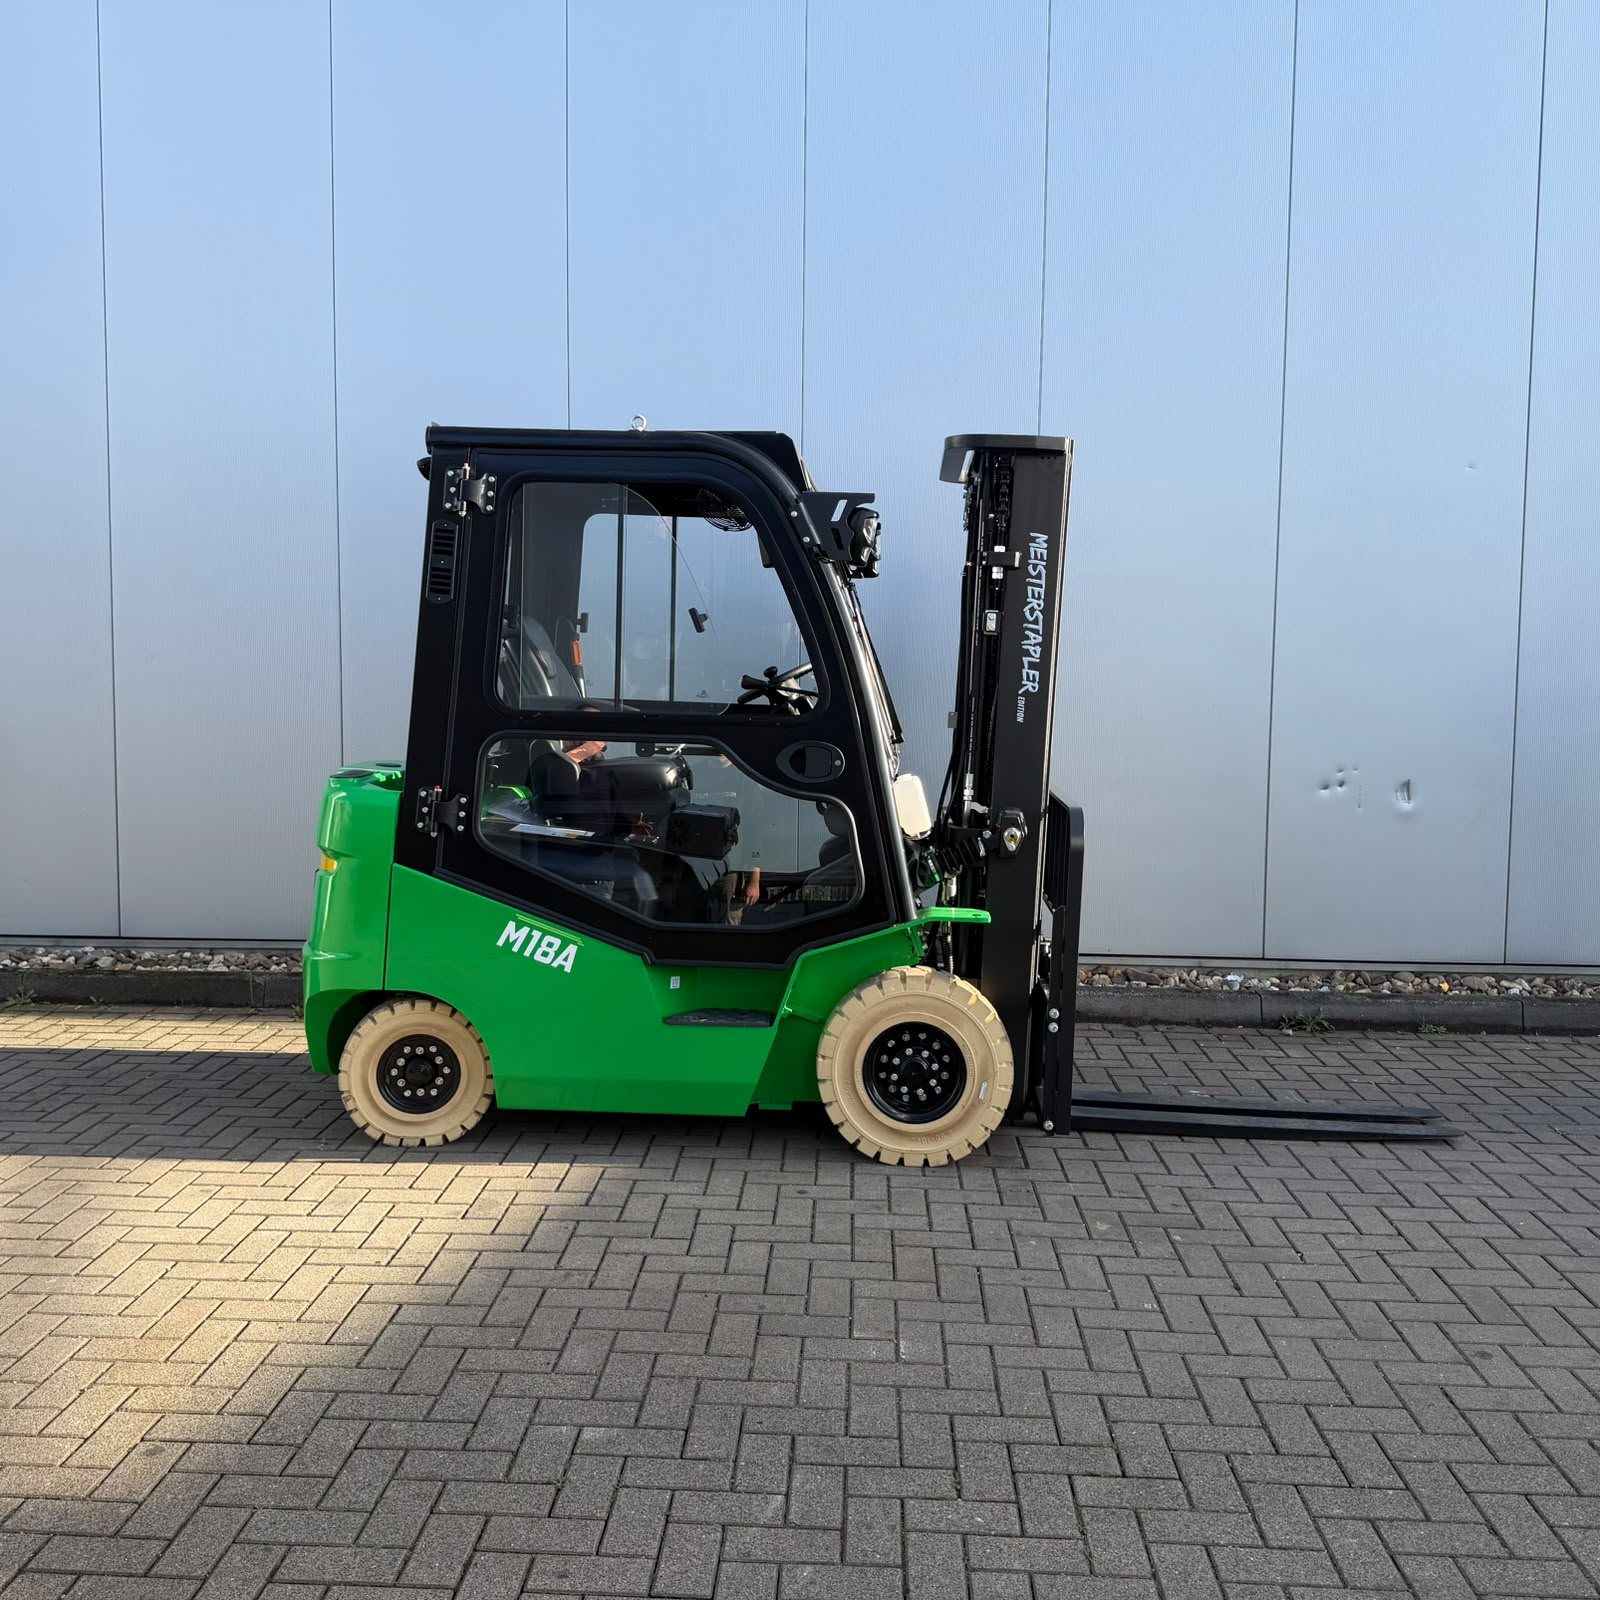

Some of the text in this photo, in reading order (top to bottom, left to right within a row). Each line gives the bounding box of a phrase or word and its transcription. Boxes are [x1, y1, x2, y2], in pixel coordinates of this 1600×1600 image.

[1016, 532, 1049, 723] MEISTERSTAPLER EDITION
[496, 920, 578, 973] M18A
